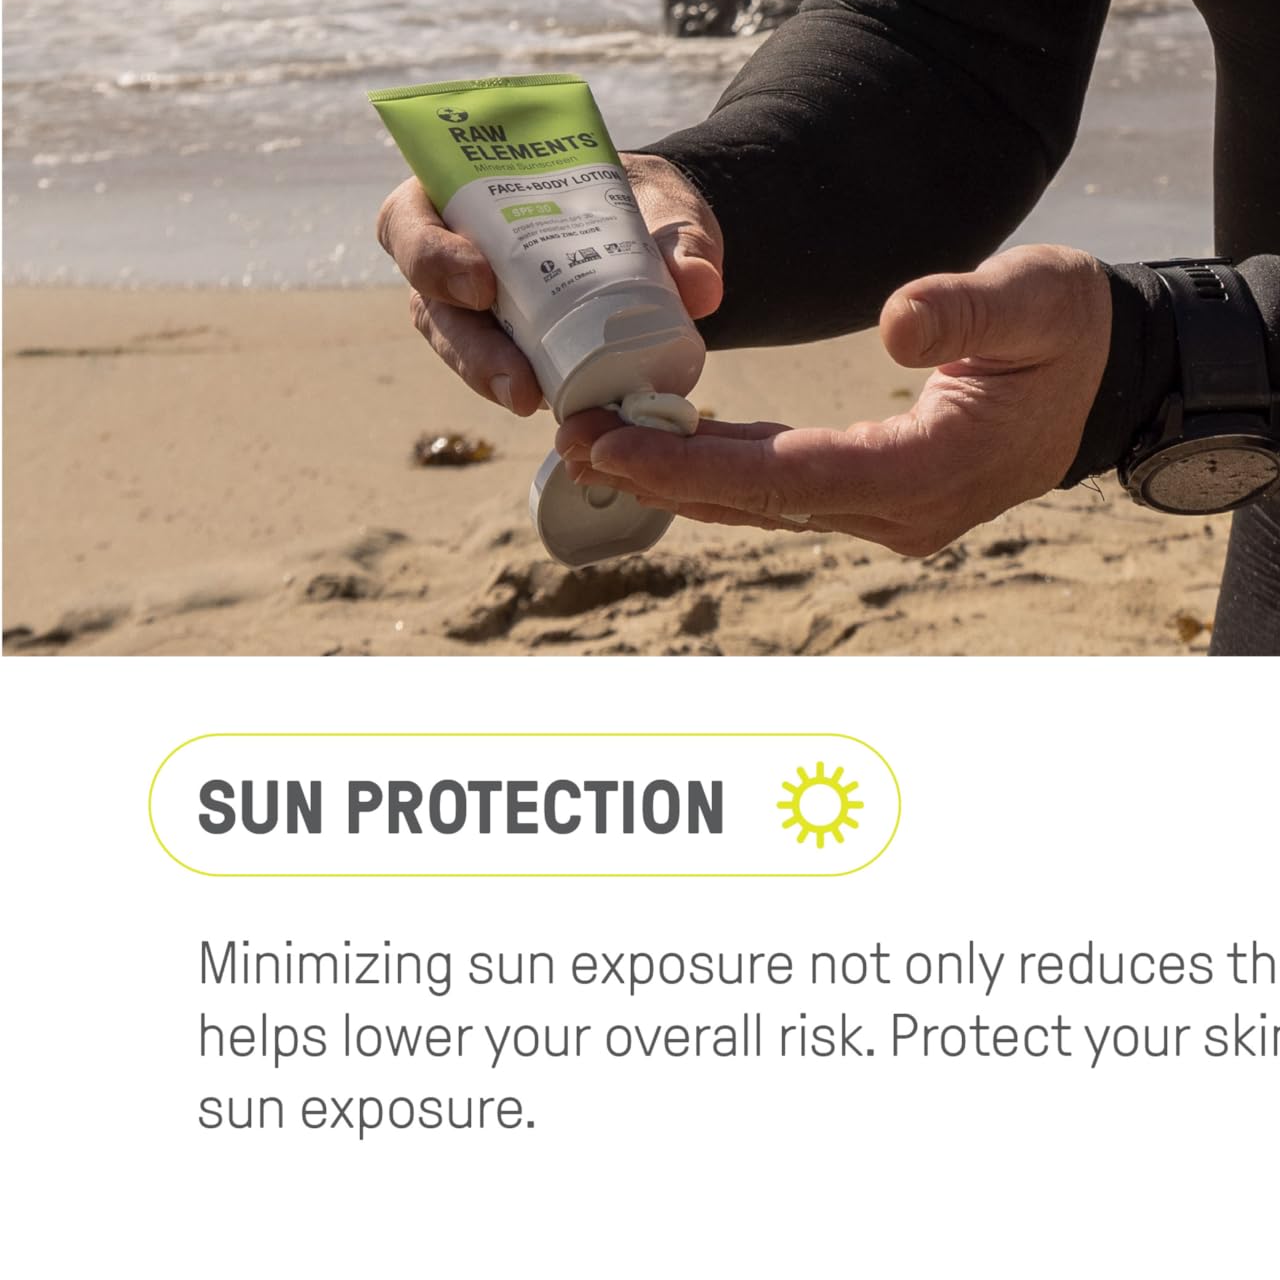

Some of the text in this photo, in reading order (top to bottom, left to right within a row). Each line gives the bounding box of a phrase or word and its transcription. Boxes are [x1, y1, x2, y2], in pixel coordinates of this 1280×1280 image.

[448, 124, 508, 143] RAW
[460, 132, 599, 162] ELEMENTS
[473, 155, 579, 174] Mineral Sunscreen
[488, 170, 622, 196] FACE+BODY LOTION
[511, 203, 552, 218] SPF 30
[522, 238, 541, 251] NON
